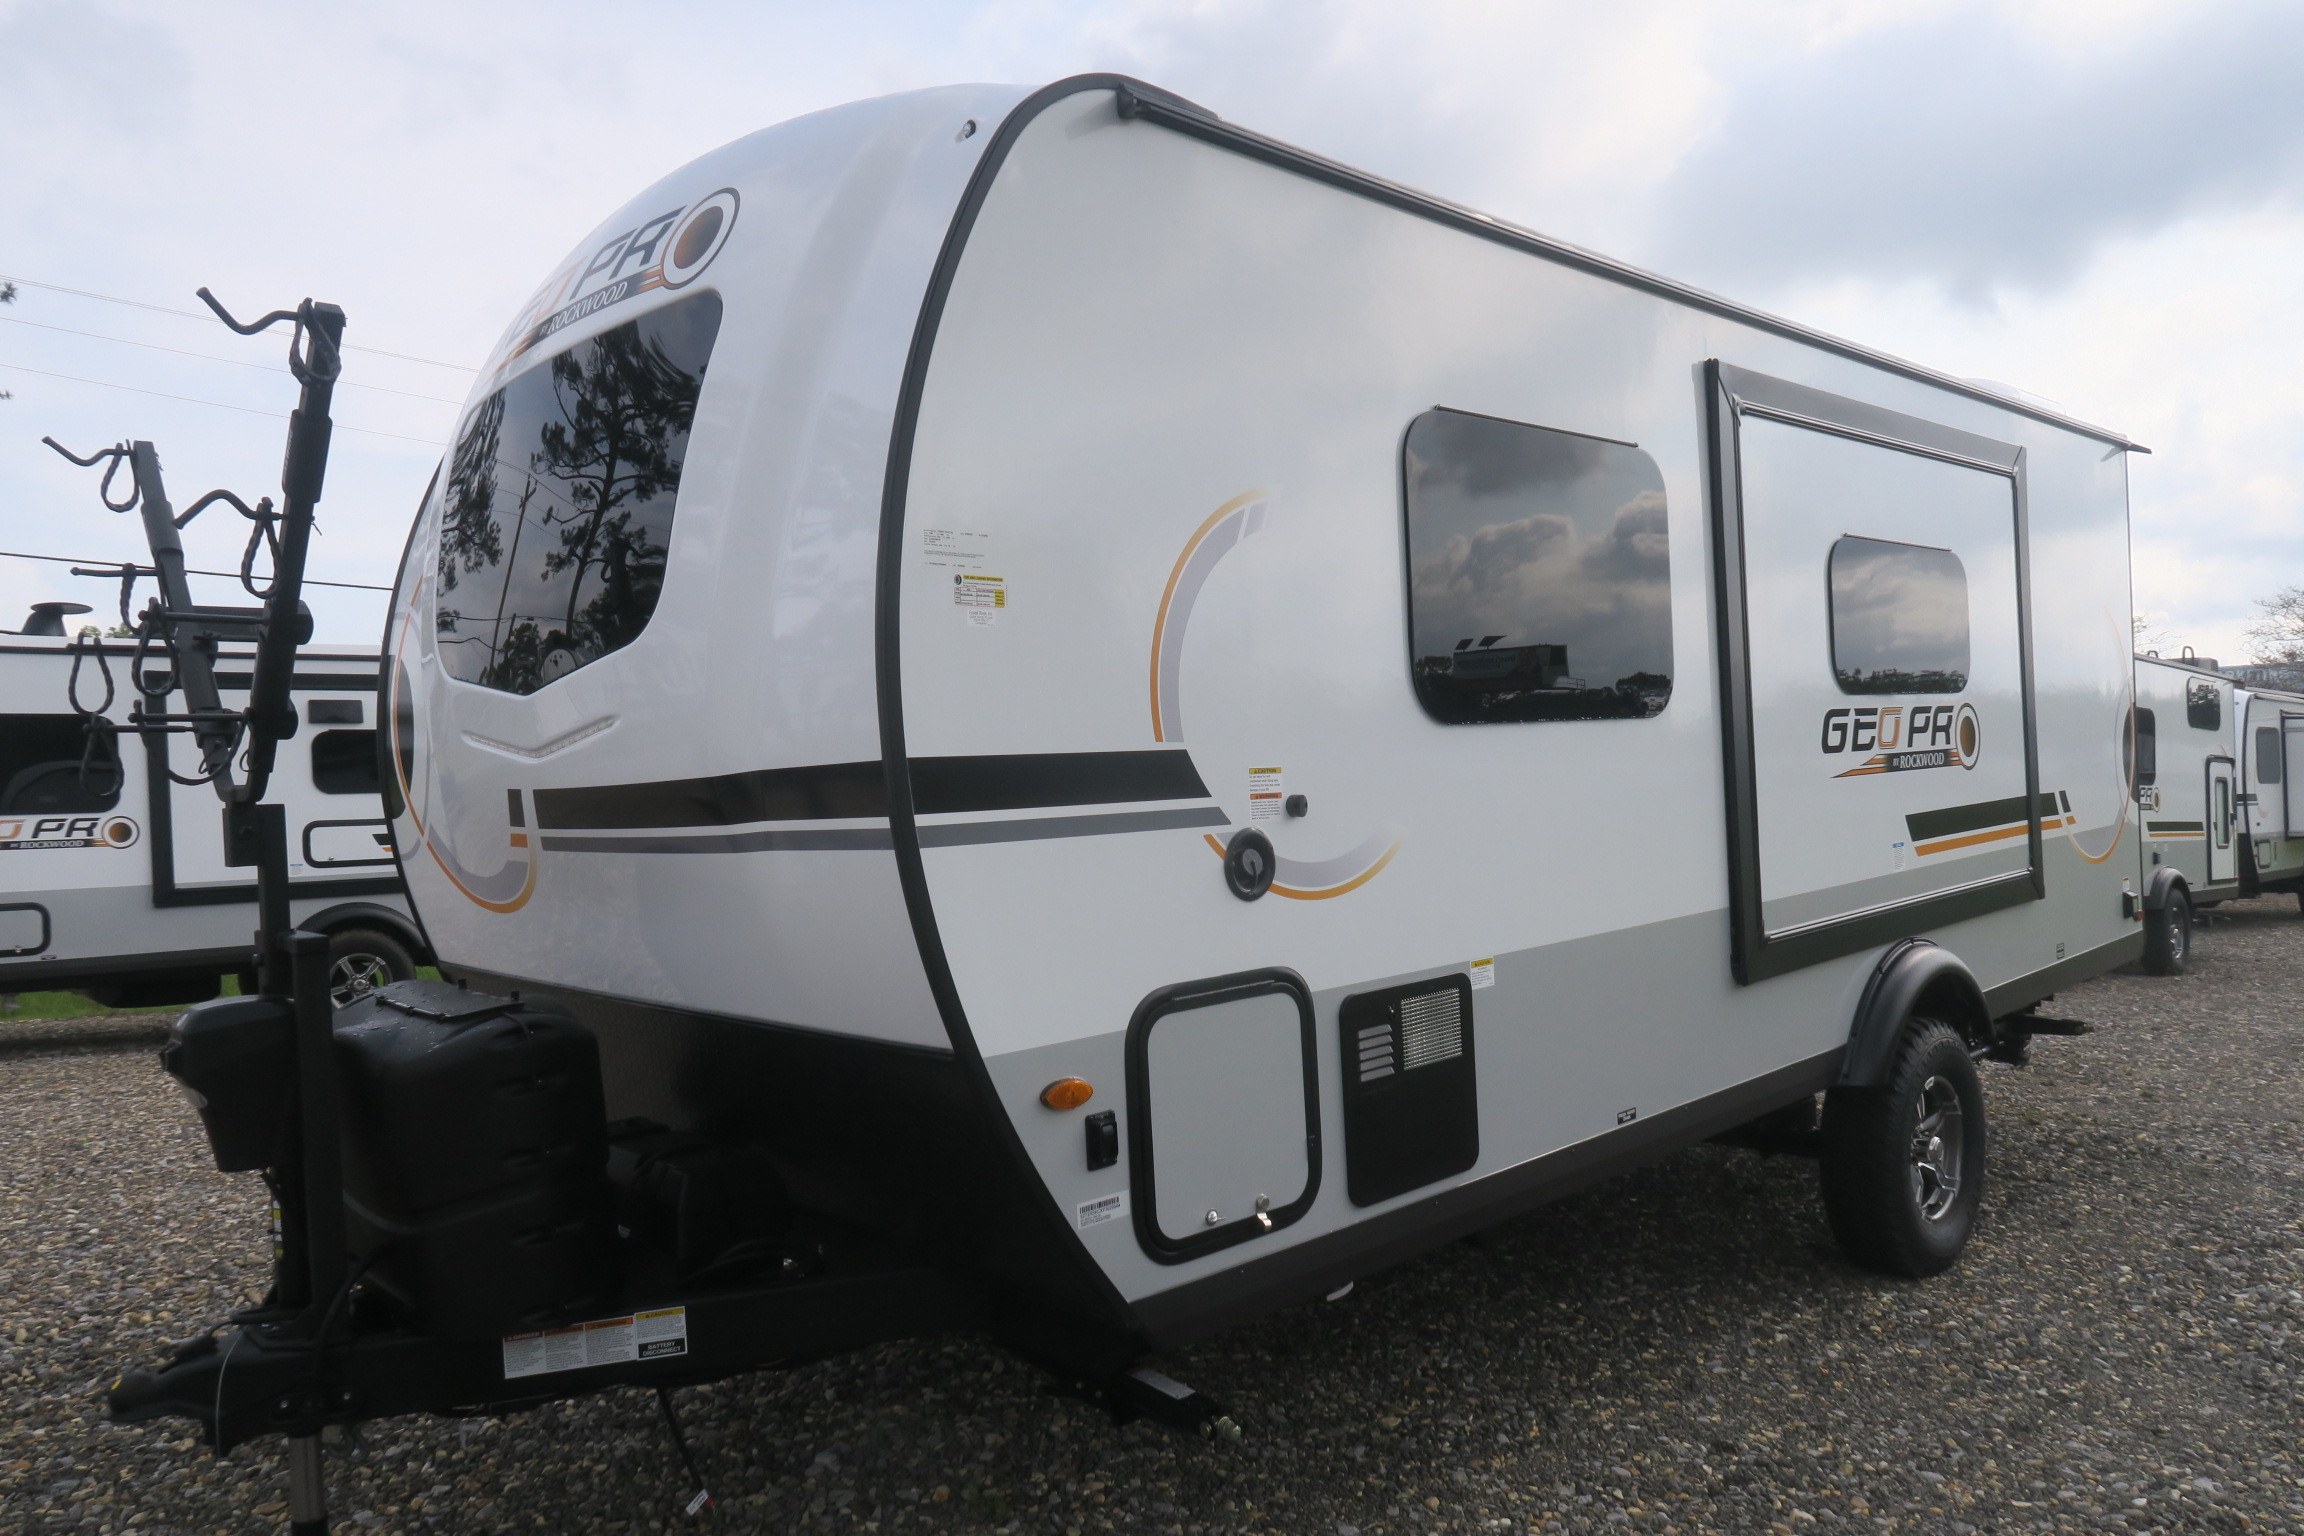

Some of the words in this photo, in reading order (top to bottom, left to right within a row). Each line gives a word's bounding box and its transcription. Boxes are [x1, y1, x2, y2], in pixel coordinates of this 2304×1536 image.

[549, 281, 629, 336] ROCKWOOD
[1821, 706, 1903, 755] GEO
[1892, 757, 1900, 768] BY
[1900, 752, 1945, 769] ROCKWOOD
[20, 840, 84, 849] ROCKWOOD
[642, 1345, 682, 1357] DISCONNECT
[647, 1341, 676, 1351] BATTERY
